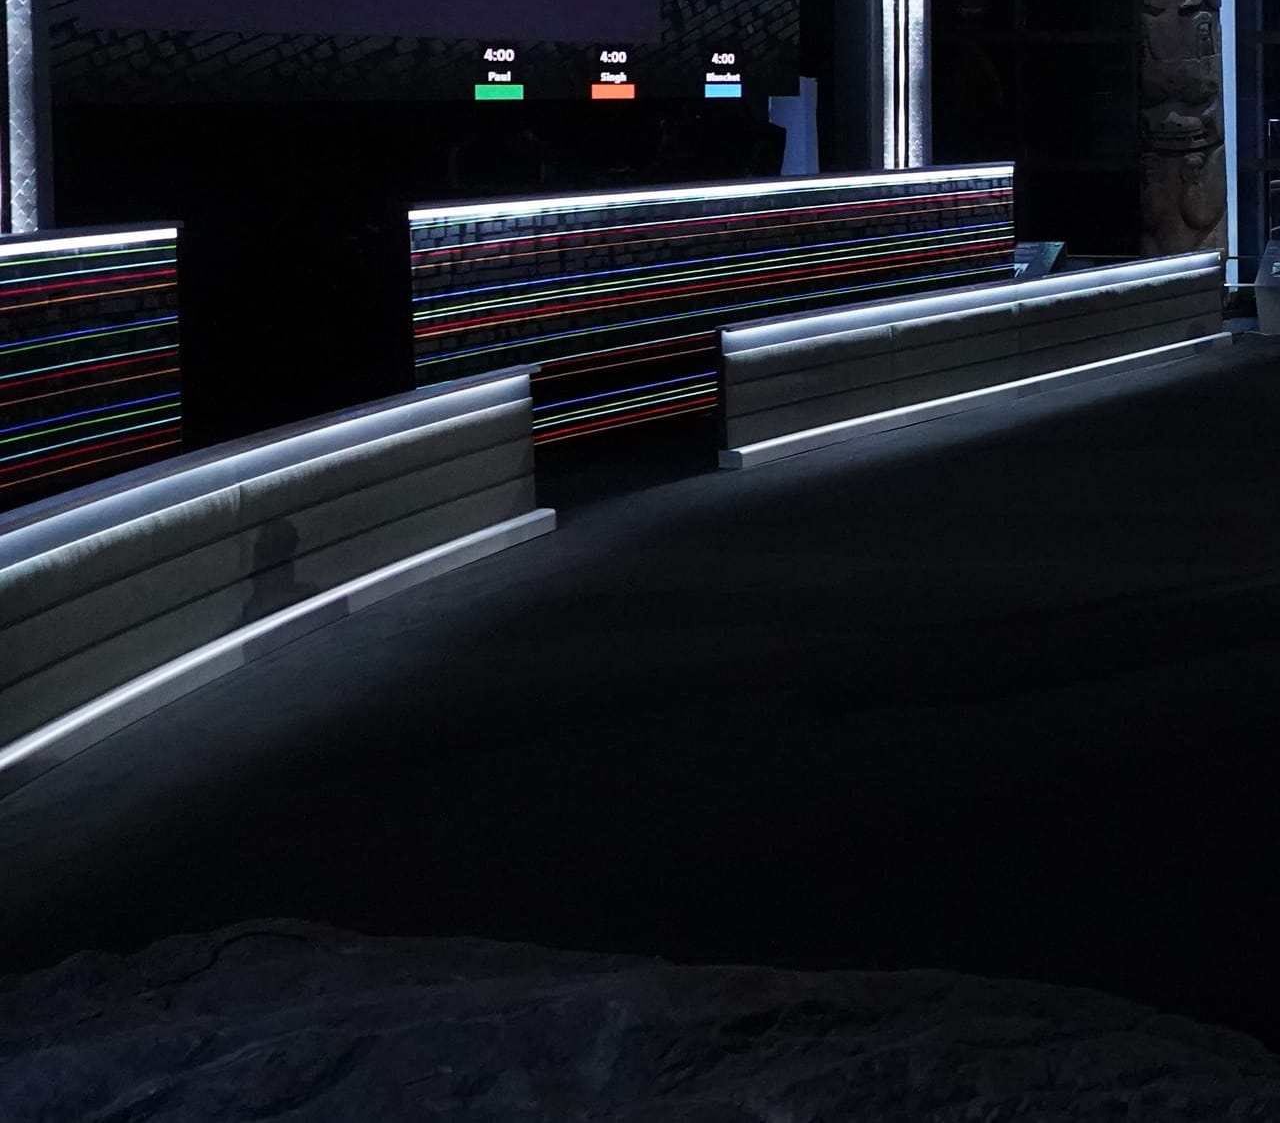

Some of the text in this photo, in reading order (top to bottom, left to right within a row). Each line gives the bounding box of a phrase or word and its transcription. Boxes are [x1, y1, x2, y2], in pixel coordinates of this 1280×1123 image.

[483, 48, 515, 62] 4:00
[599, 50, 628, 64] 4:00
[711, 52, 736, 65] 4:00
[487, 71, 512, 82] Paul
[600, 71, 628, 84] Singh
